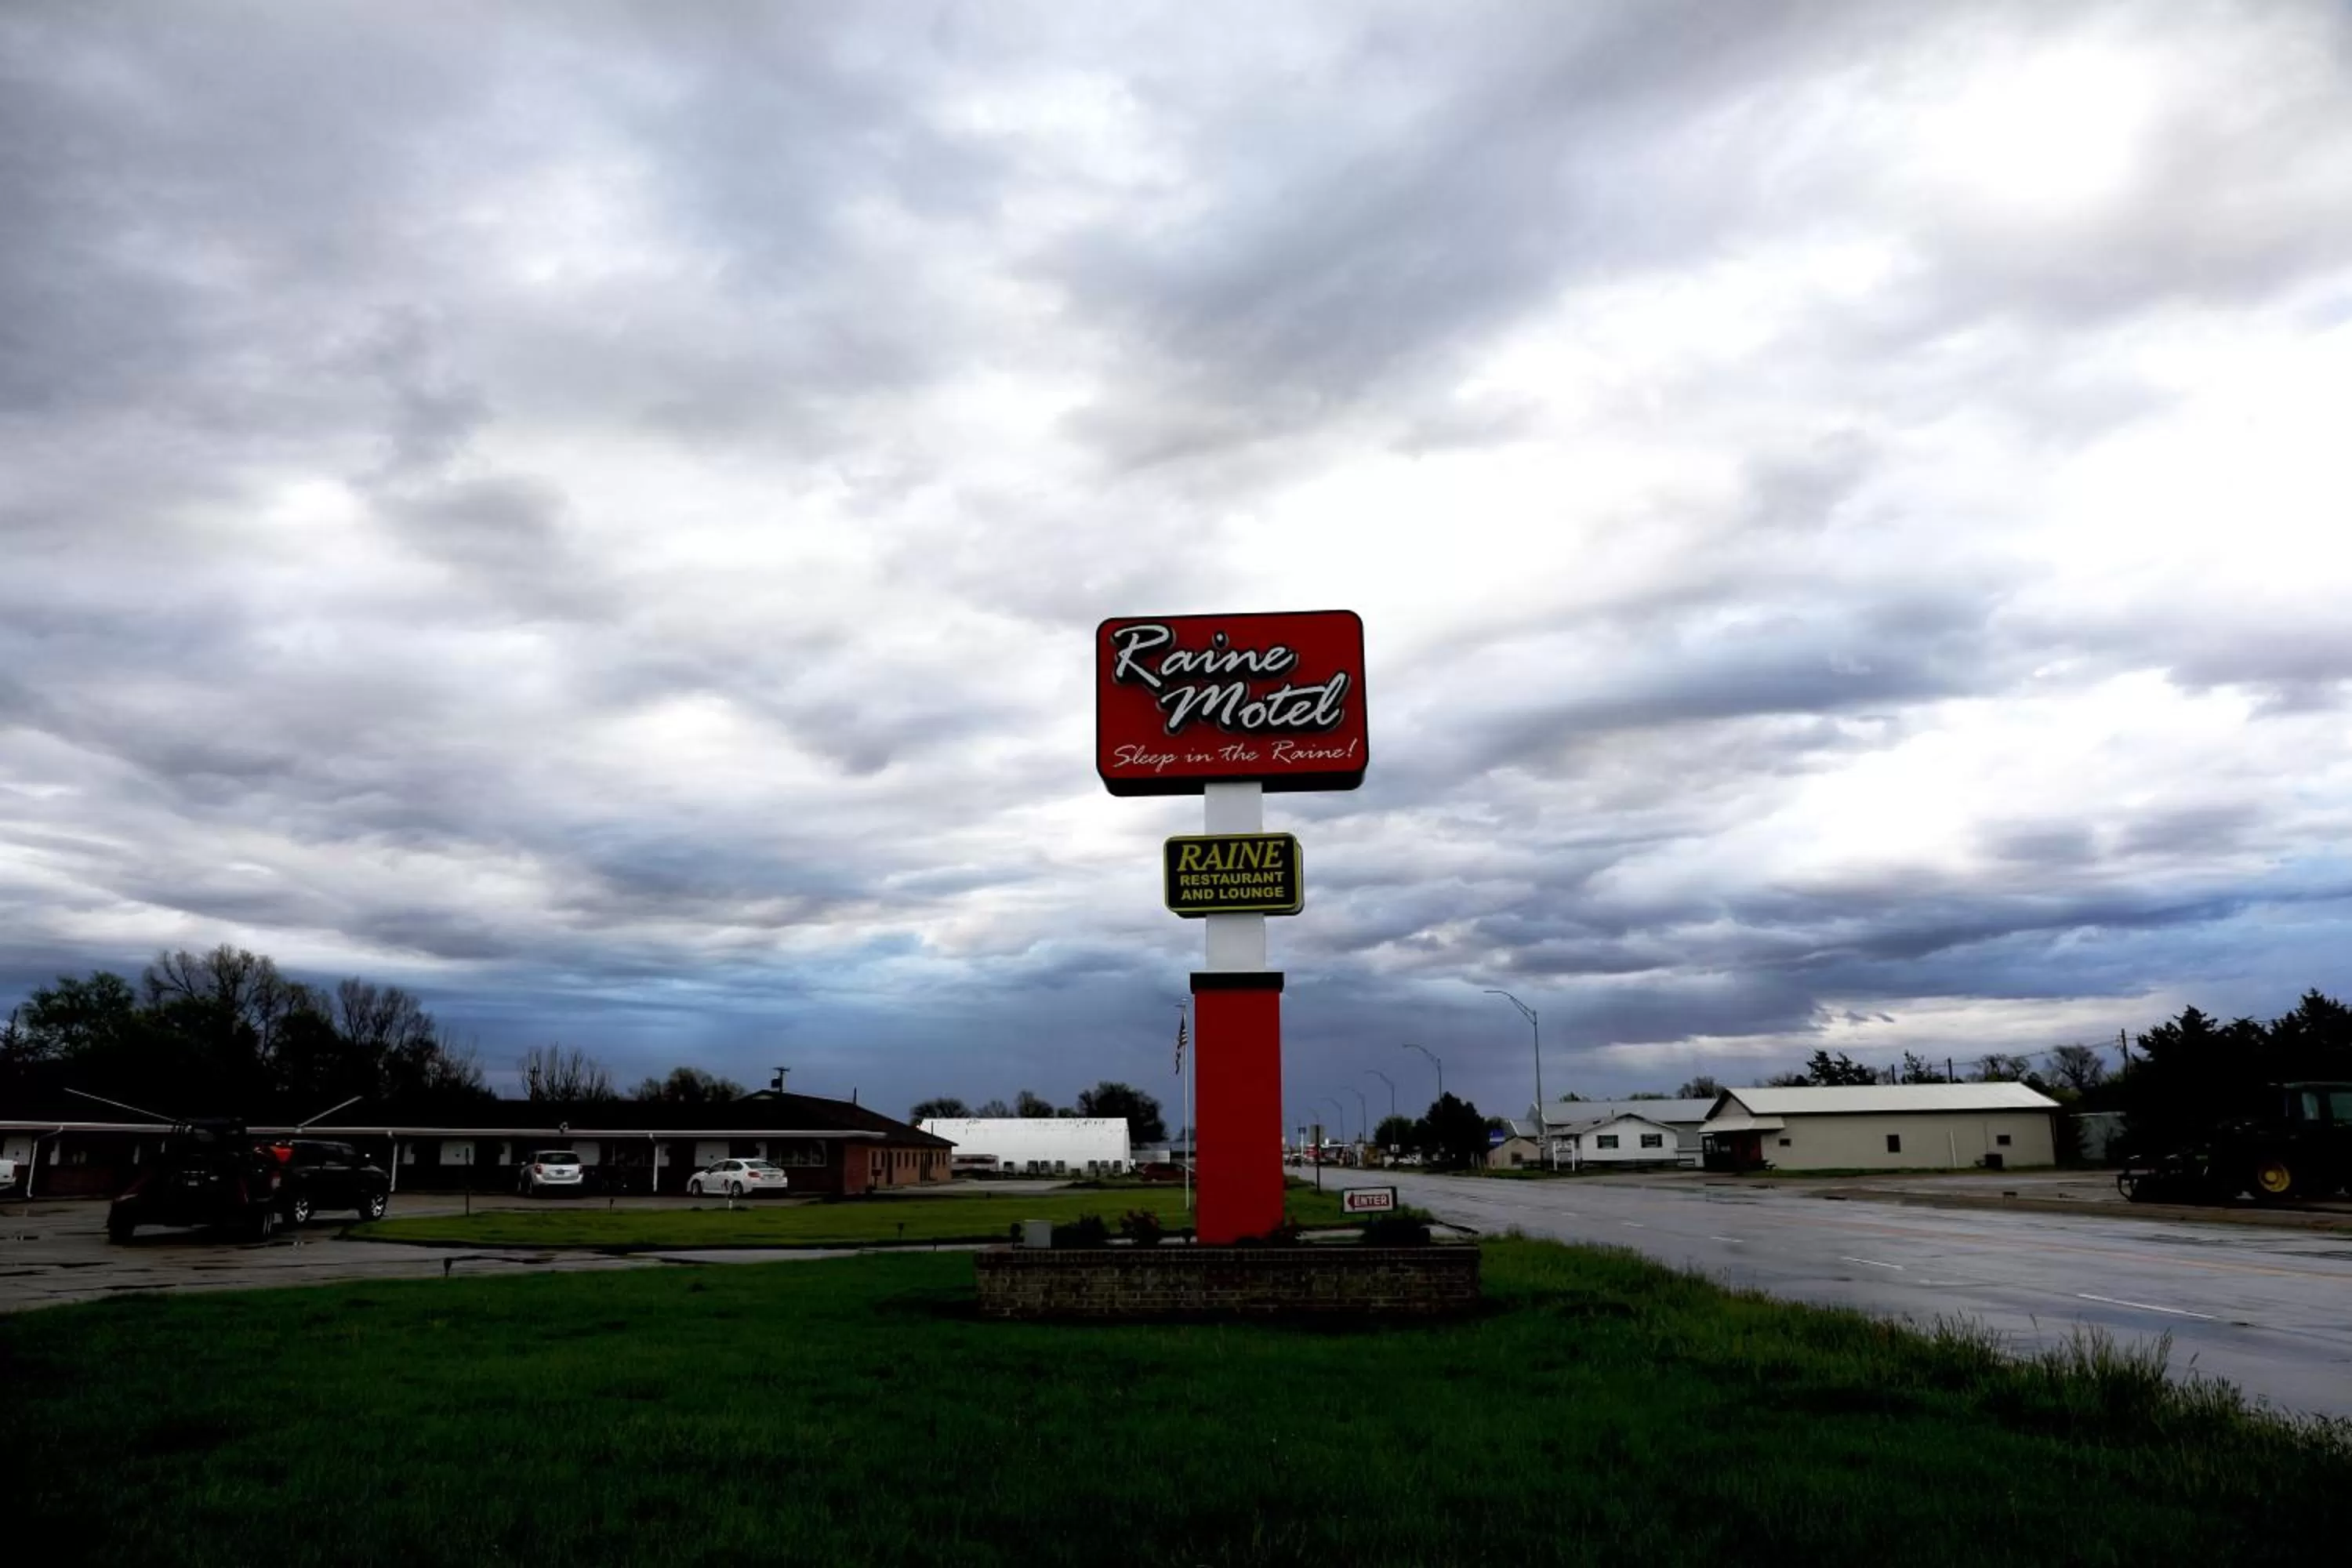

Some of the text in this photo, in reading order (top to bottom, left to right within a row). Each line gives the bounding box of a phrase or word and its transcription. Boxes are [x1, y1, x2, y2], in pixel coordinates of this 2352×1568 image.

[1114, 625, 1294, 687] Raine
[1161, 673, 1346, 728] Motel
[1113, 739, 1357, 772] Sleep in the Raine!
[1177, 840, 1285, 871] RAINE
[1180, 871, 1285, 886] RESTAURANT
[1181, 887, 1285, 901] AND LOUNGE
